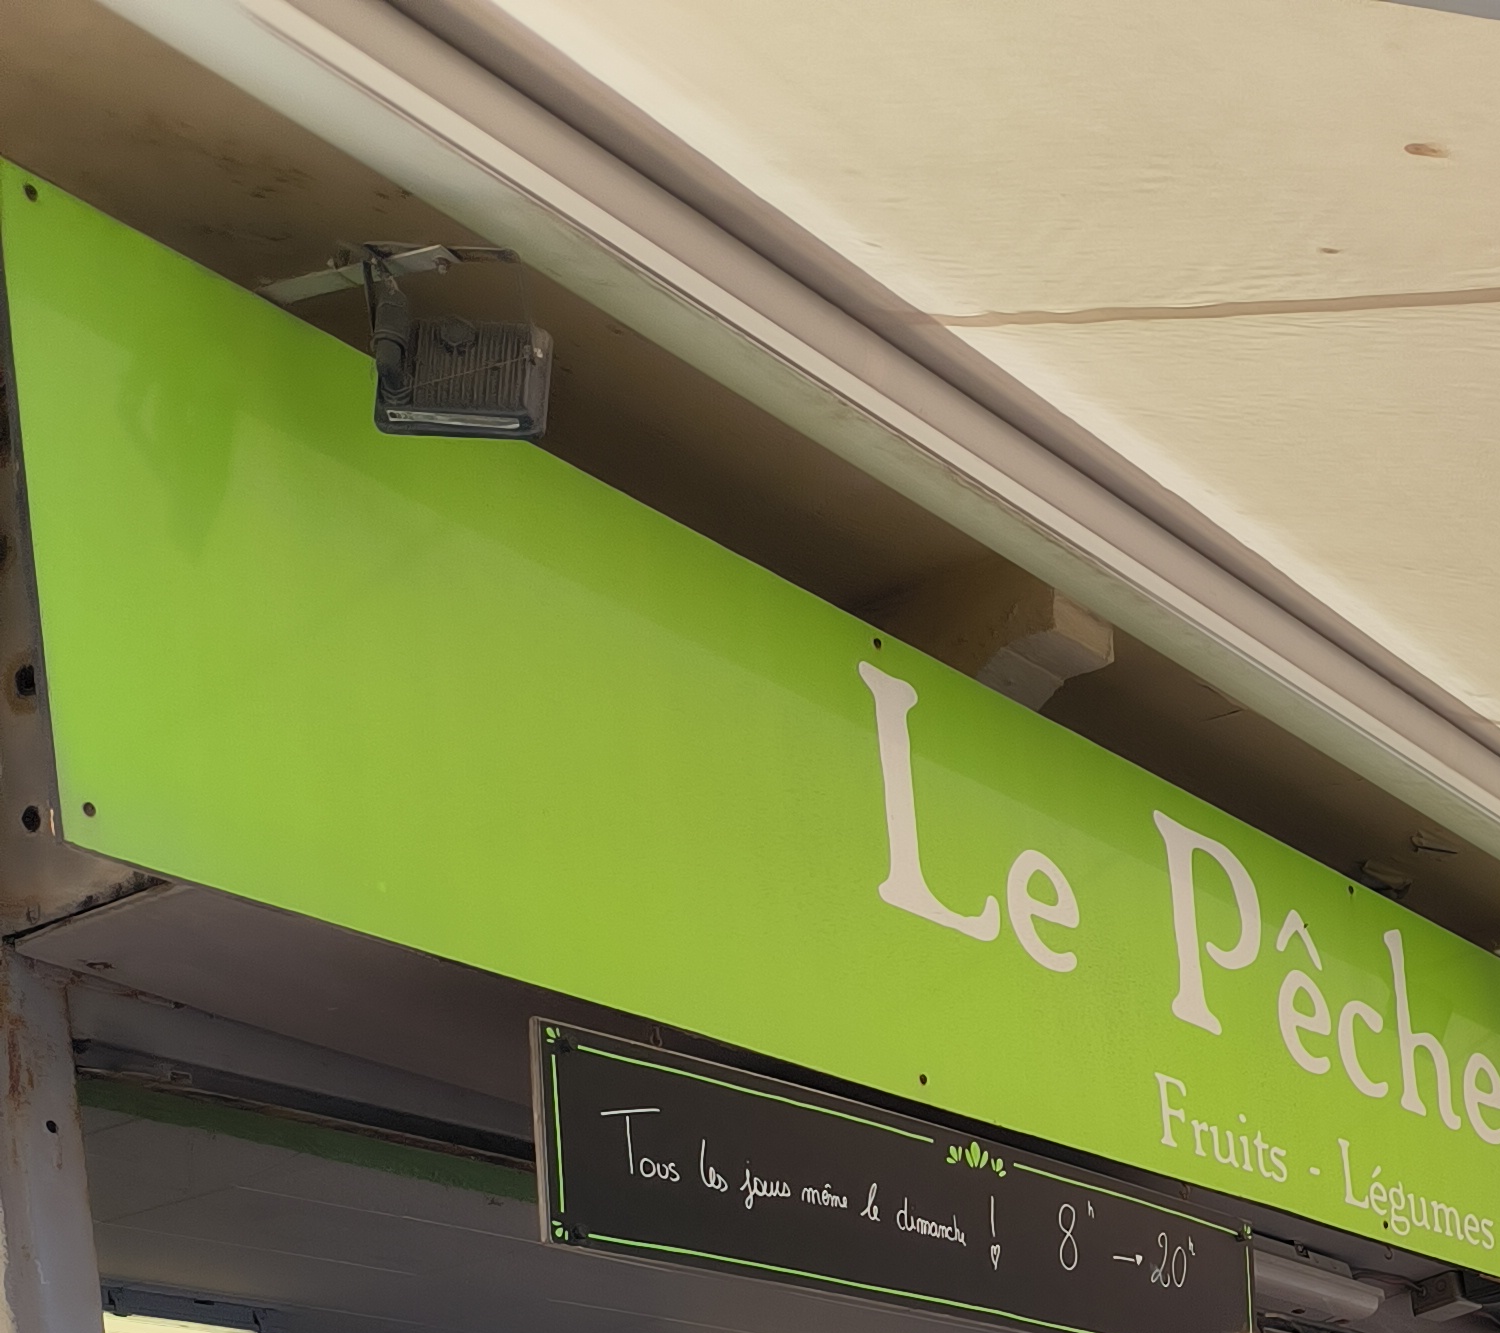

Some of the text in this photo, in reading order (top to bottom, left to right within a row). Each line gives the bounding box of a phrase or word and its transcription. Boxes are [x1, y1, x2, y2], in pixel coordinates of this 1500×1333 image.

[858, 661, 1080, 972] Le
[601, 1108, 680, 1182] Tous
[701, 1139, 728, 1192] les
[802, 1184, 847, 1208] même
[861, 1182, 880, 1222] le
[897, 1196, 966, 1246] dimanche
[1154, 1072, 1288, 1182] Fruits
[1338, 1138, 1495, 1249] Légumes
